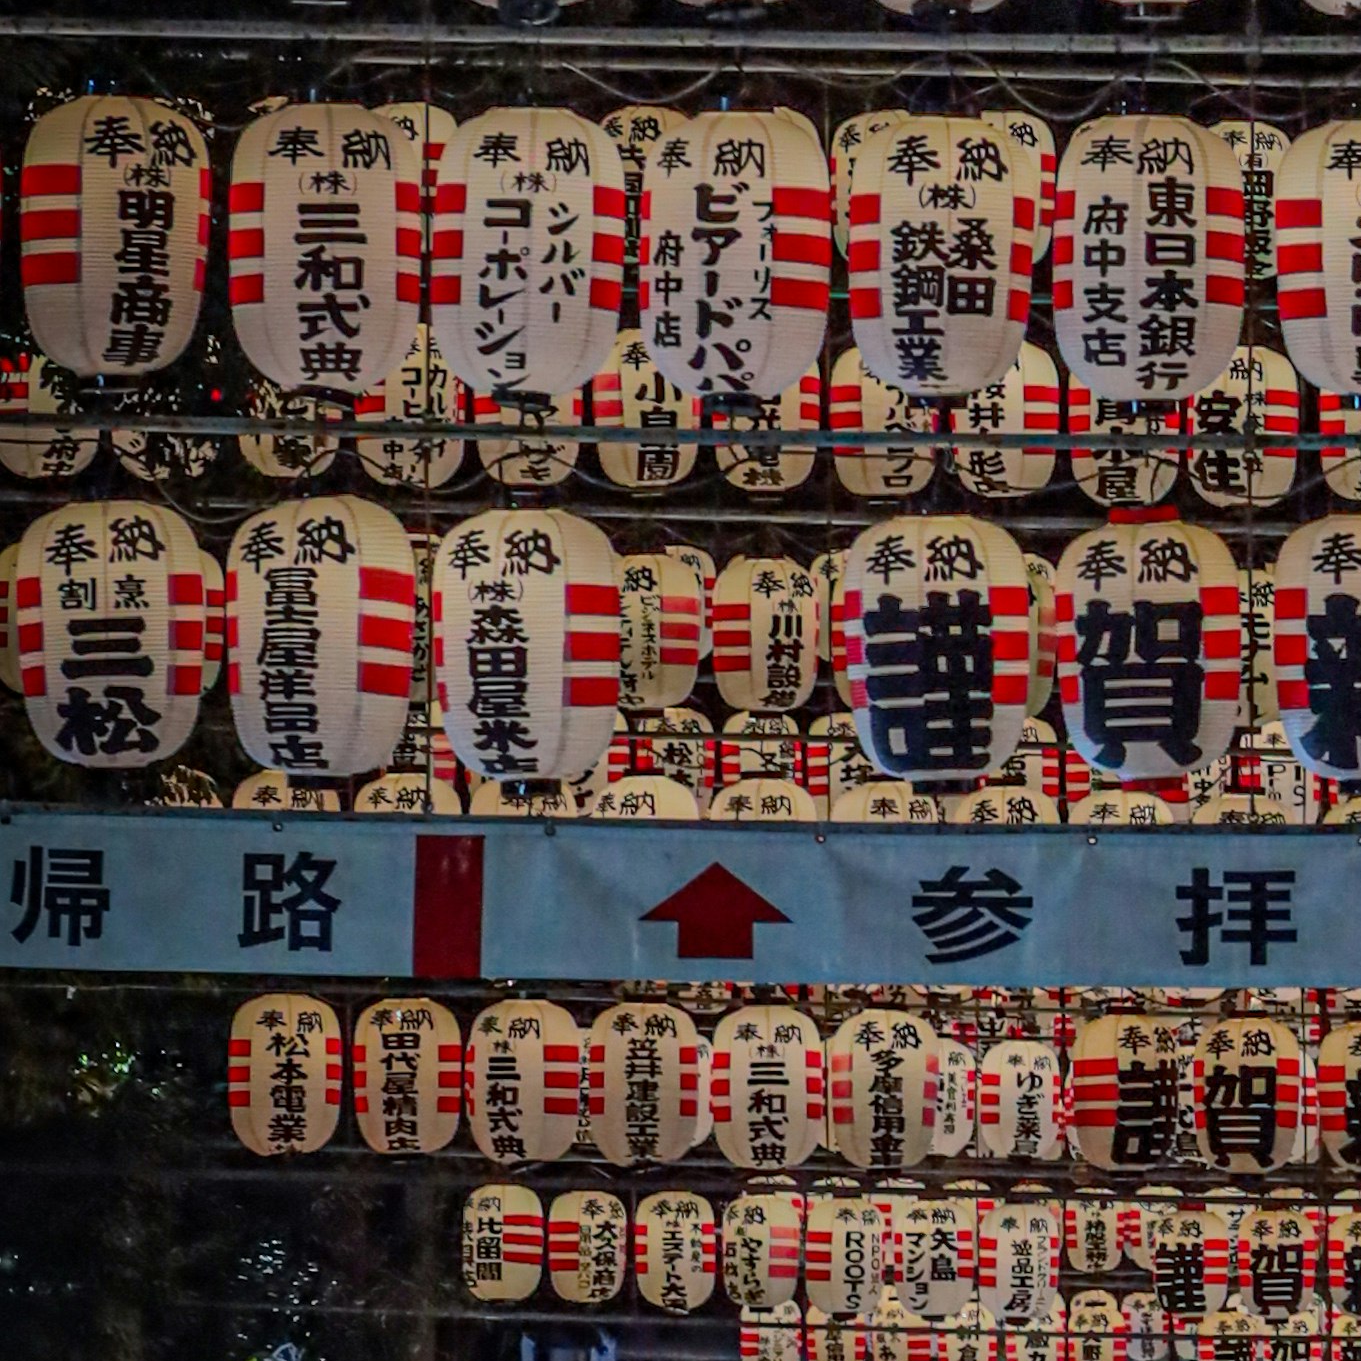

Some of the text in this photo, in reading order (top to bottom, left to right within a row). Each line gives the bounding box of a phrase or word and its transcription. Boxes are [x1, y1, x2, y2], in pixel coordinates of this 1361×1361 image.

[85, 117, 194, 167] 奉納
[1081, 135, 1194, 175] 奉納
[104, 189, 175, 367] 明星商事
[295, 201, 370, 382] 三和式典
[539, 204, 585, 323] シルバー
[652, 232, 684, 348] 府中店
[944, 217, 999, 317] 桑田
[1082, 195, 1129, 367] 府中支店
[1137, 178, 1198, 392] 東日本銀行
[60, 579, 150, 611] 割烹
[448, 529, 560, 577] 奉納
[57, 619, 162, 755] 三松
[865, 592, 990, 772] 謹
[1075, 599, 1203, 767] 賀
[9, 846, 342, 952] 帰路
[855, 1022, 922, 1048] 奉納
[267, 1034, 308, 1142] 松本電業
[486, 1057, 526, 1159] 三和式典
[747, 1062, 788, 1164] 三和式典
[1205, 1066, 1277, 1167] 賀
[844, 1231, 863, 1310] ROOTS
[906, 1232, 931, 1310] マンション
[930, 1228, 957, 1281] 矢島
[1252, 1246, 1304, 1314] 賀
